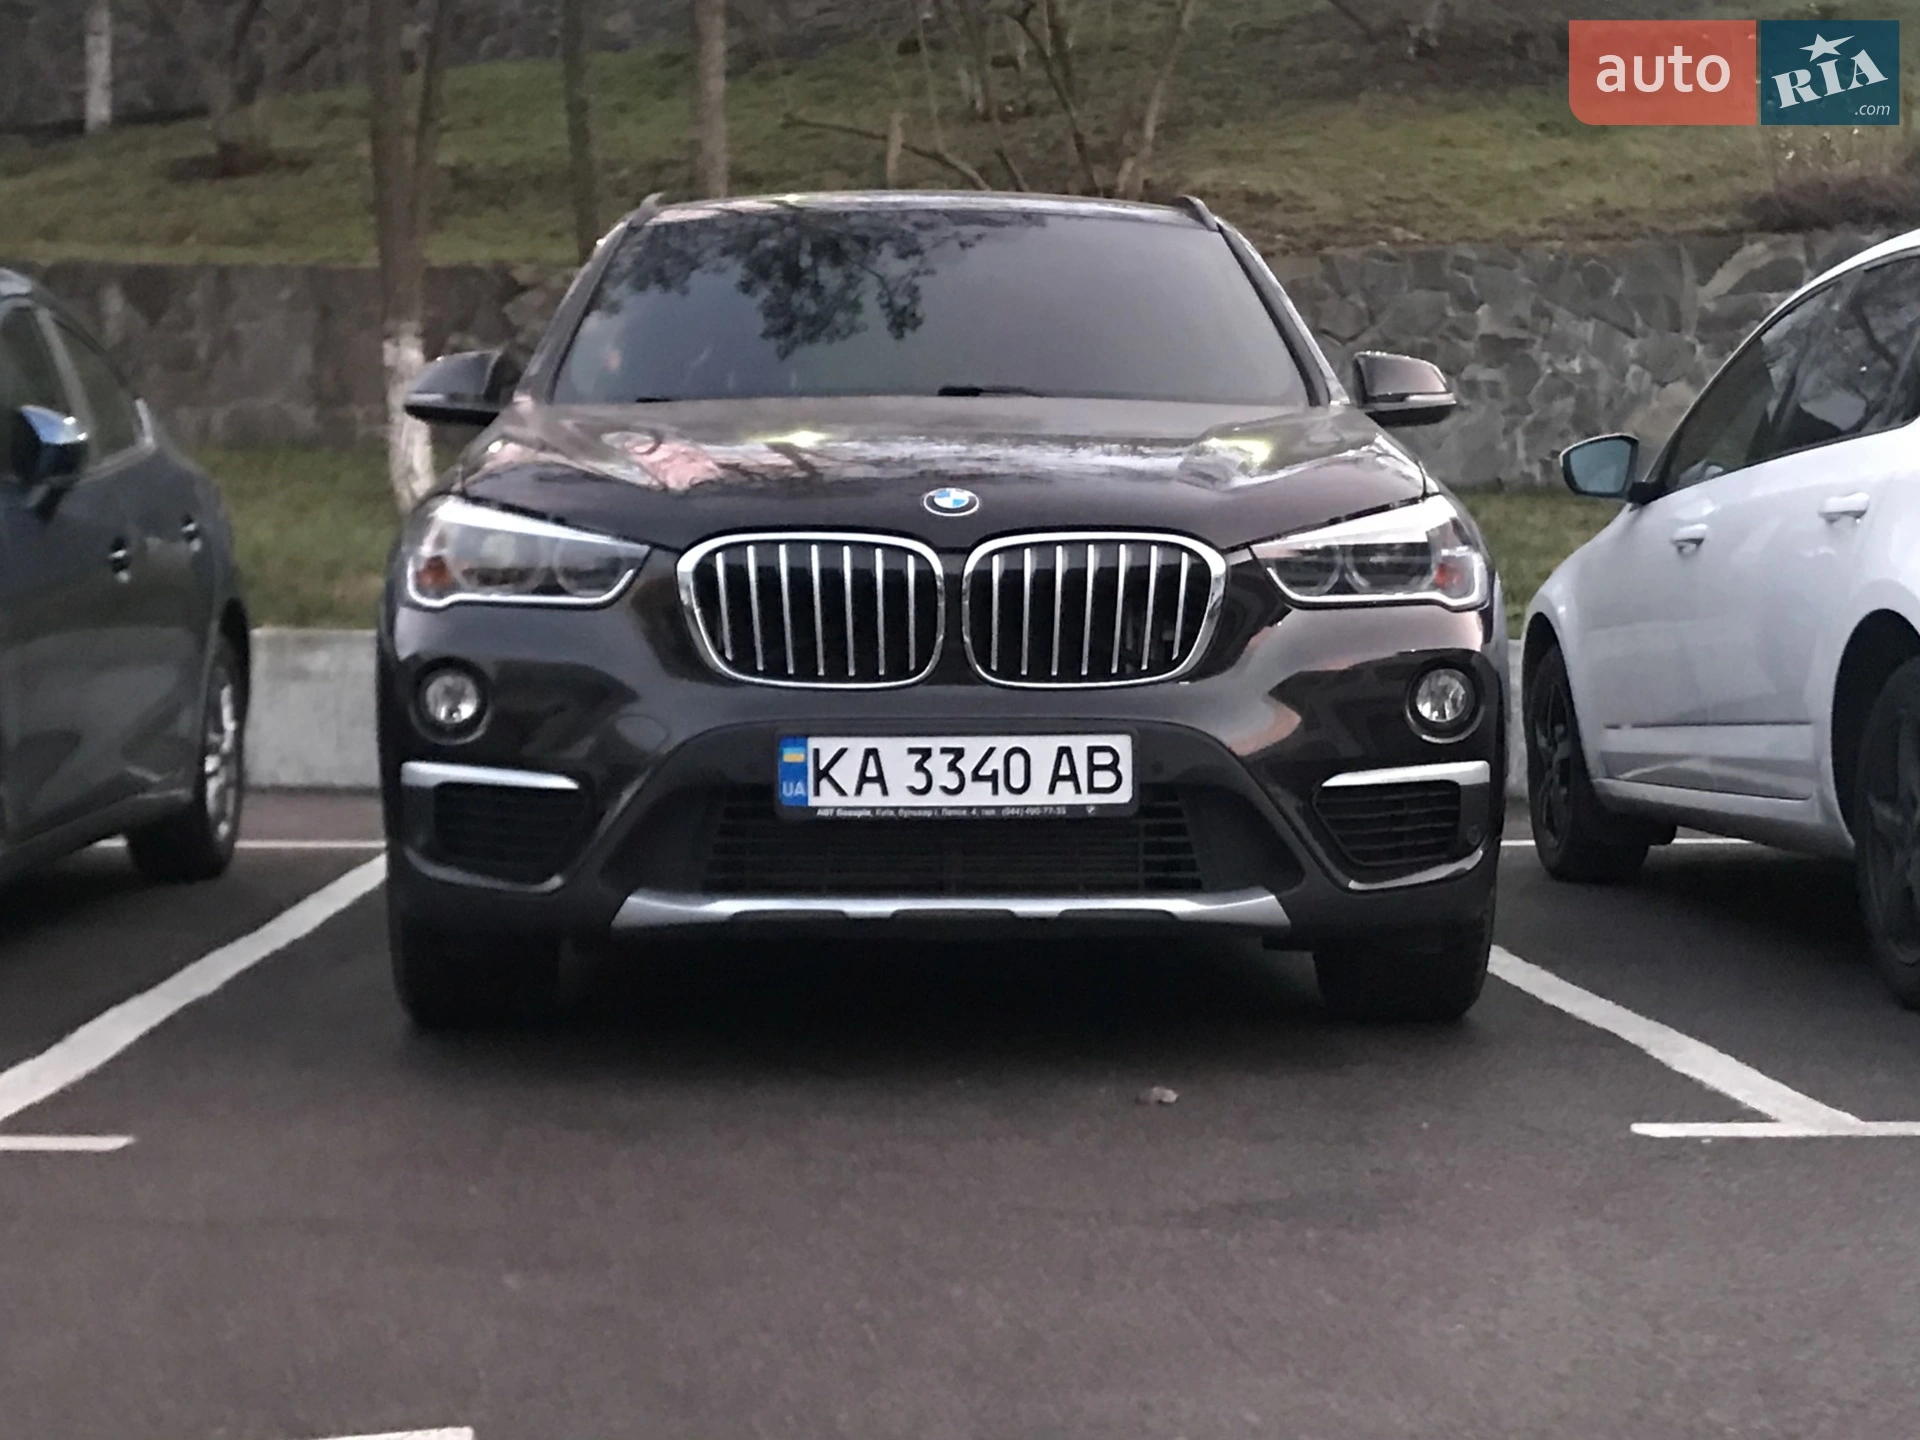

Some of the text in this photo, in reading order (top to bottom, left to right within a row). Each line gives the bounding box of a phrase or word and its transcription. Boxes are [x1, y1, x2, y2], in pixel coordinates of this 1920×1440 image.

[812, 745, 1123, 797] KA 3340 AB
[782, 781, 806, 797] UA
